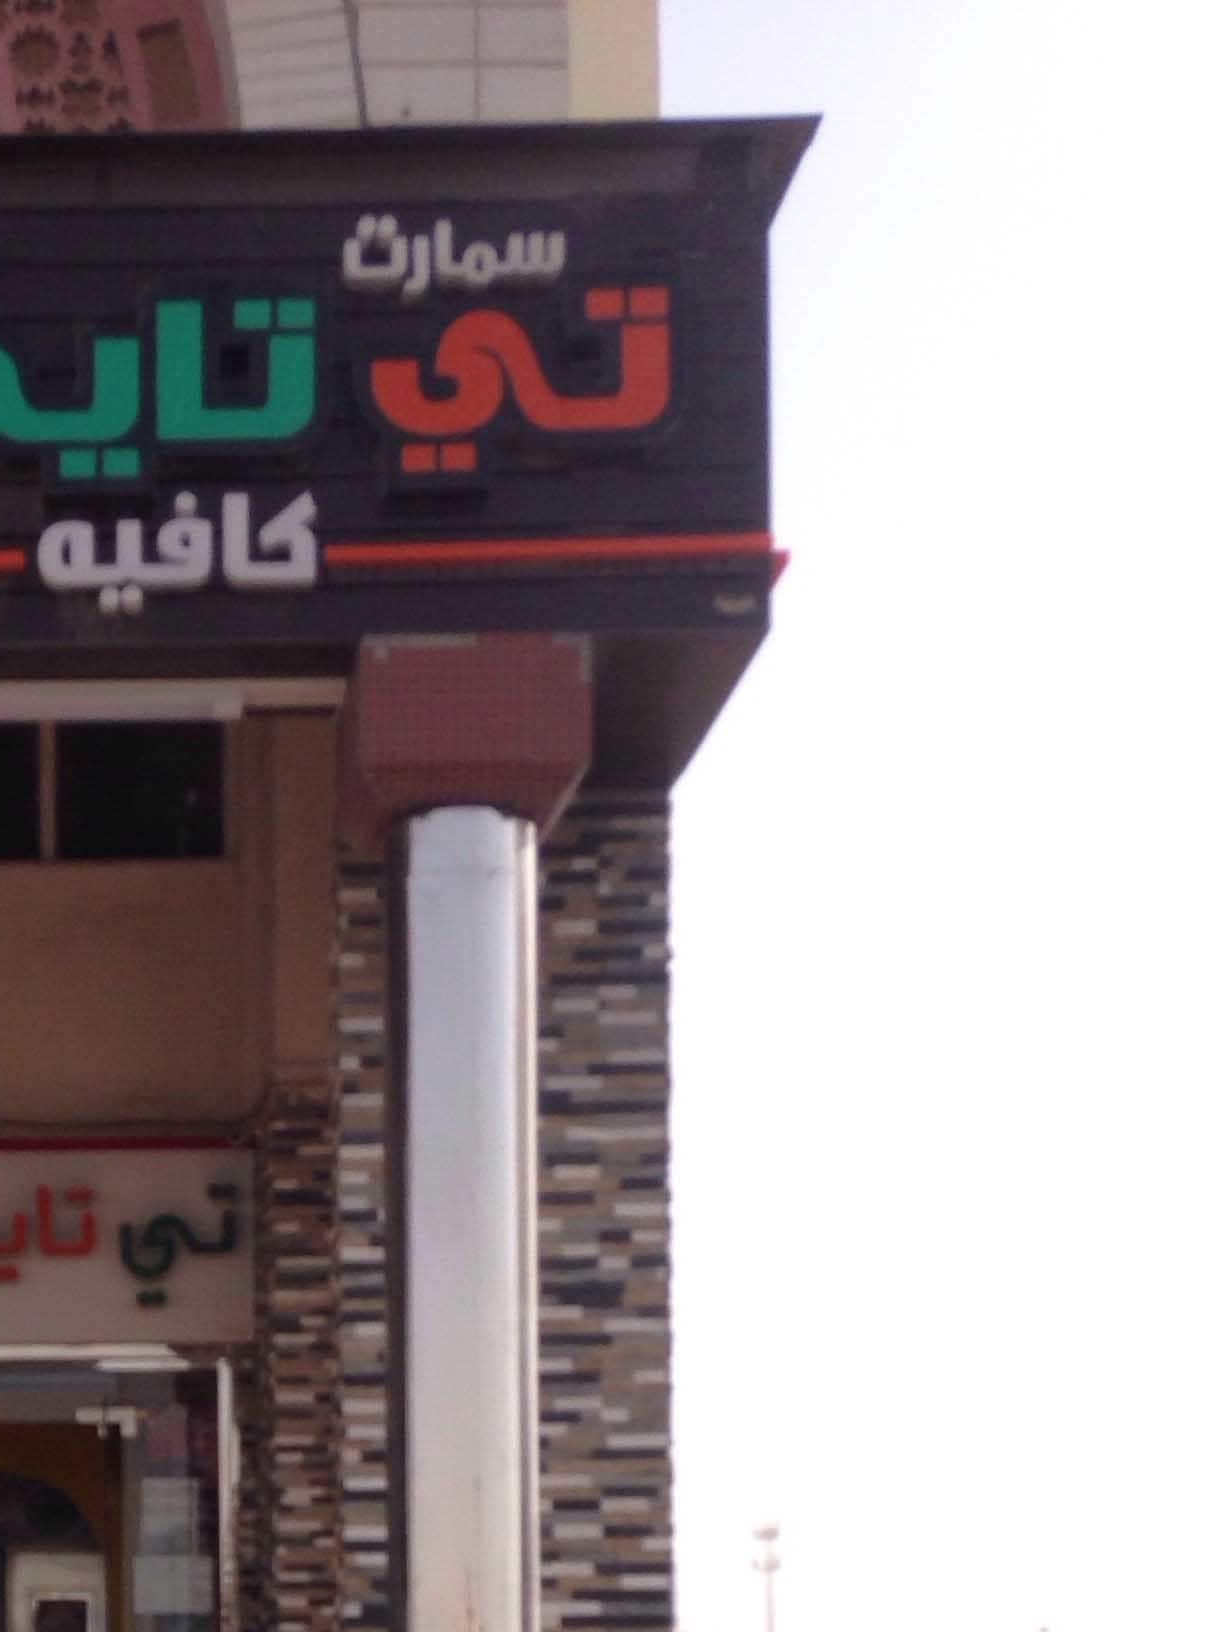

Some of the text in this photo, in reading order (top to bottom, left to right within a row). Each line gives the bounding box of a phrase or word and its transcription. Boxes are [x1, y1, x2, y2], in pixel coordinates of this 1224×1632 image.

[342, 213, 566, 296] سمارت
[370, 286, 669, 473] تي
[36, 490, 319, 614] كافيه
[119, 1181, 241, 1307] تي
